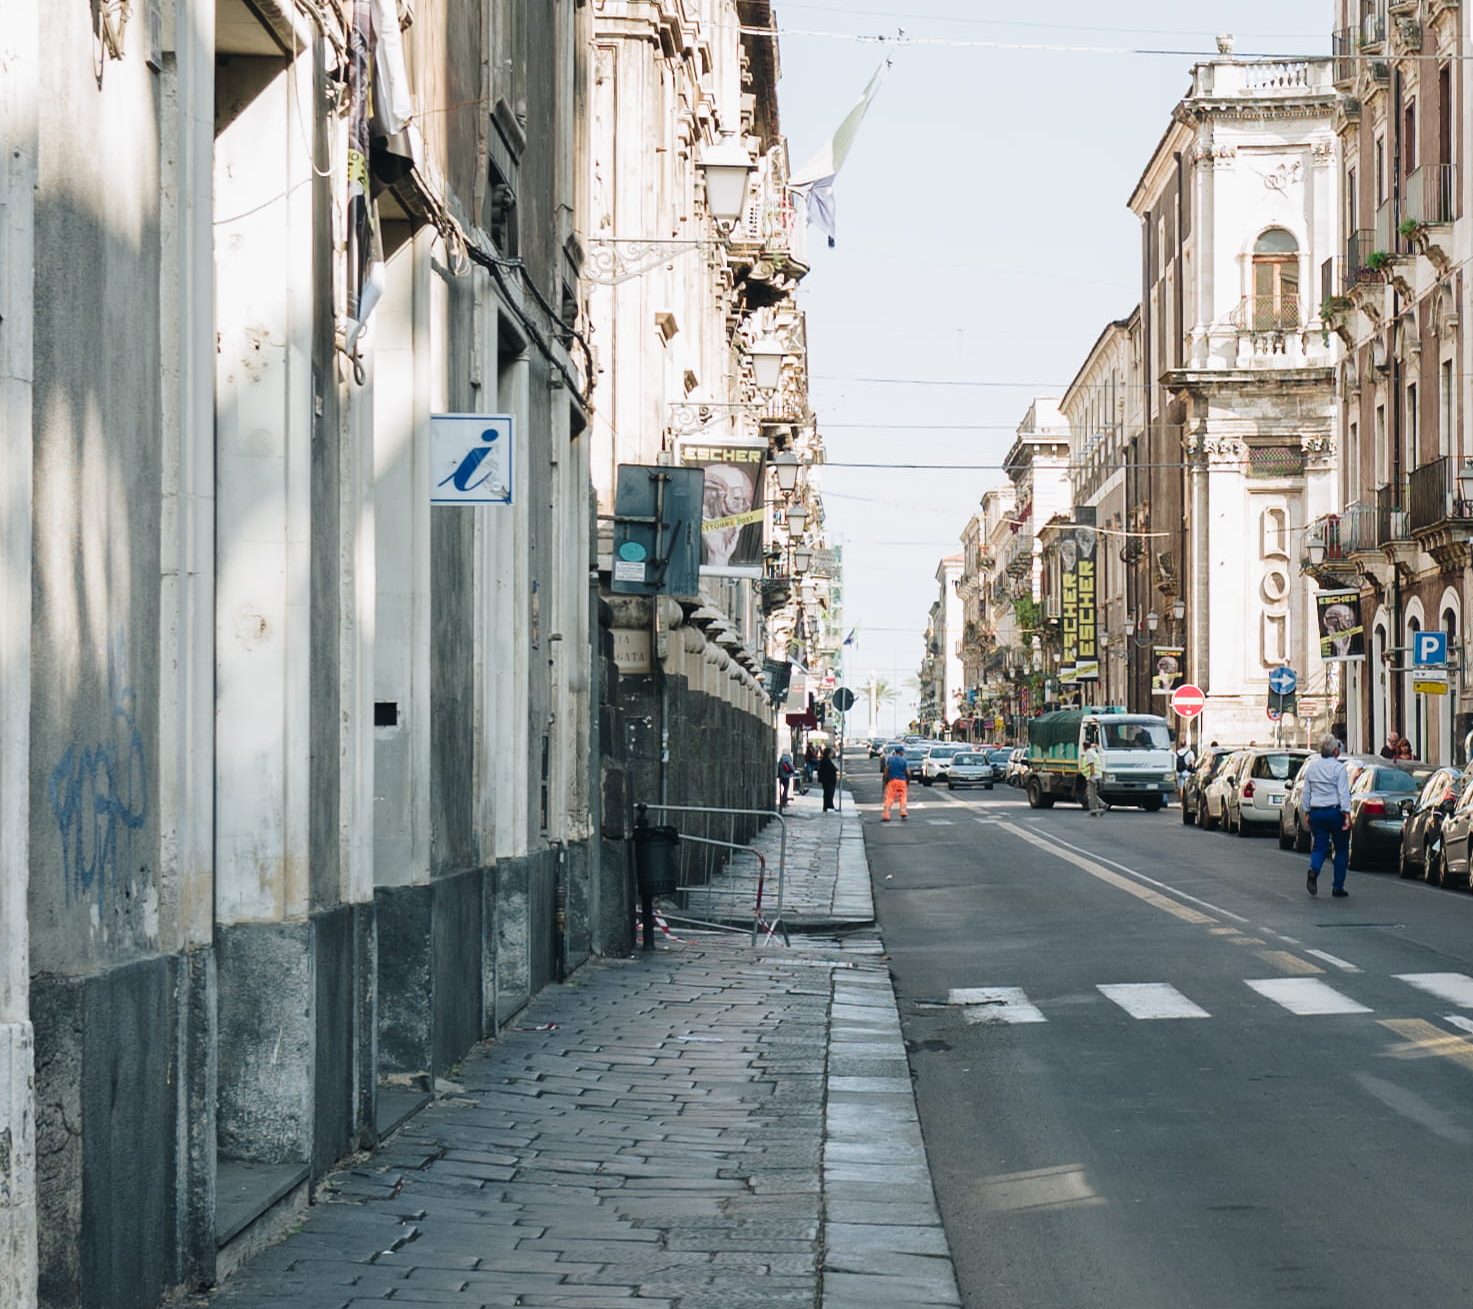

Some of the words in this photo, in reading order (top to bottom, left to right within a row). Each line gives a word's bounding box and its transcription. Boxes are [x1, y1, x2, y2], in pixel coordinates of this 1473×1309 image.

[682, 446, 762, 464] ESCHER
[1078, 560, 1095, 657] ESCHER
[1318, 595, 1358, 605] ESCHER
[1063, 572, 1078, 663] ESCHER
[1421, 636, 1439, 661] P
